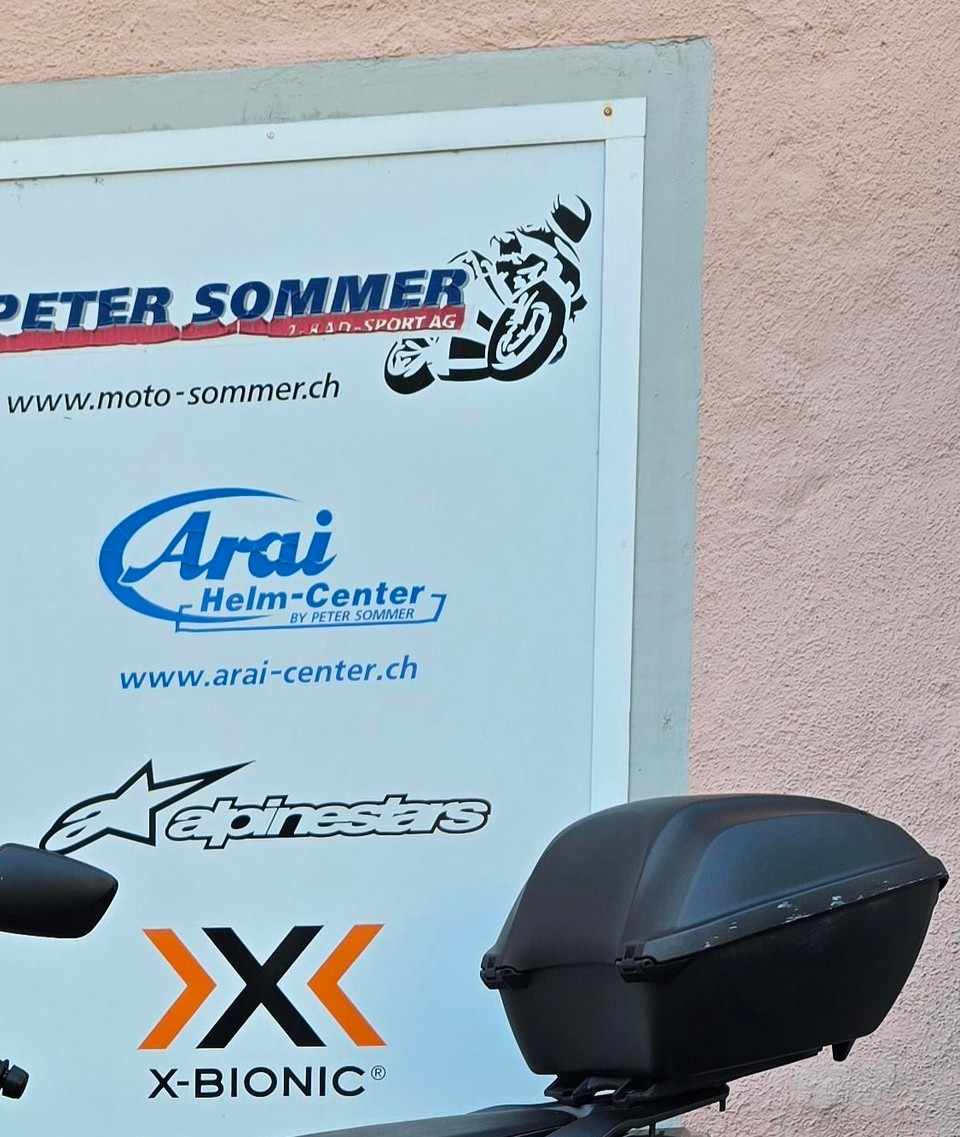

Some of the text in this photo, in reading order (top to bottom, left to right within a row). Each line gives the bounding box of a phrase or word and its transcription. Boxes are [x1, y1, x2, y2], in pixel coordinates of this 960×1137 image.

[191, 268, 469, 324] SOMMER
[429, 313, 457, 329] AG
[7, 372, 340, 414] www.moto-sommer.ch
[119, 509, 337, 581] Arai
[200, 582, 425, 613] Helm-Center
[290, 608, 415, 624] BY PETER SOMMER
[120, 655, 418, 689] www.arai-center.ch
[165, 793, 492, 850] alpinestars
